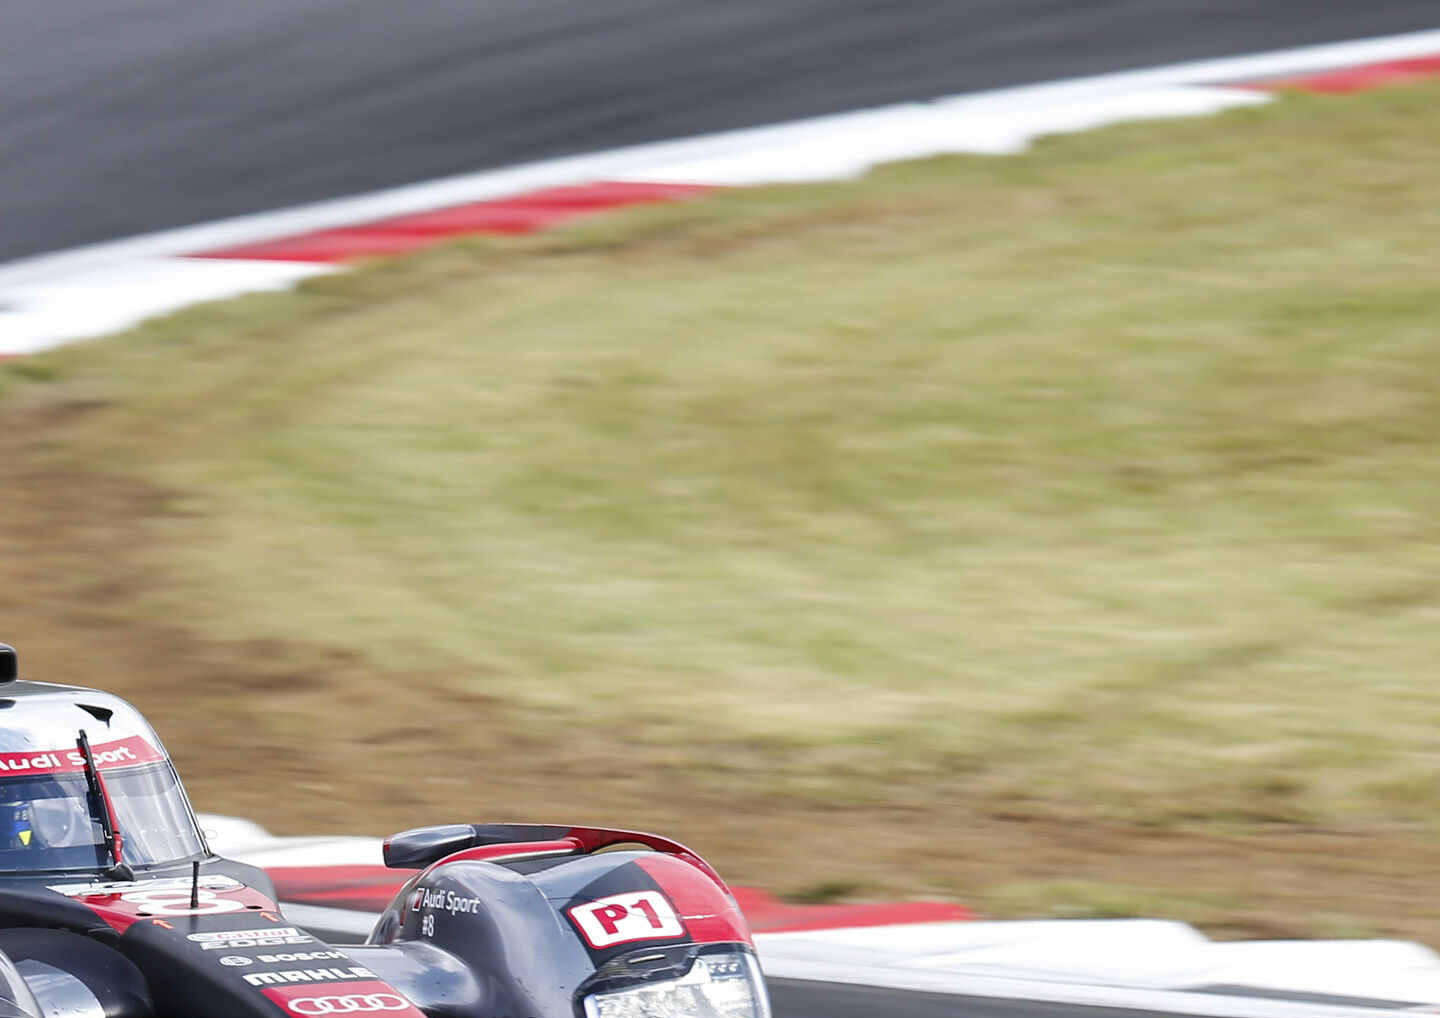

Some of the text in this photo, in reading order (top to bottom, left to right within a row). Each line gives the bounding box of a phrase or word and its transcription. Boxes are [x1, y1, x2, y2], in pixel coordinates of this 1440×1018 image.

[422, 888, 481, 916] Audi Sport
[422, 914, 435, 937] #8
[591, 899, 664, 935] P1
[200, 936, 313, 950] EDGE
[256, 951, 350, 963] BOSCH
[242, 967, 378, 987] MAHLE
